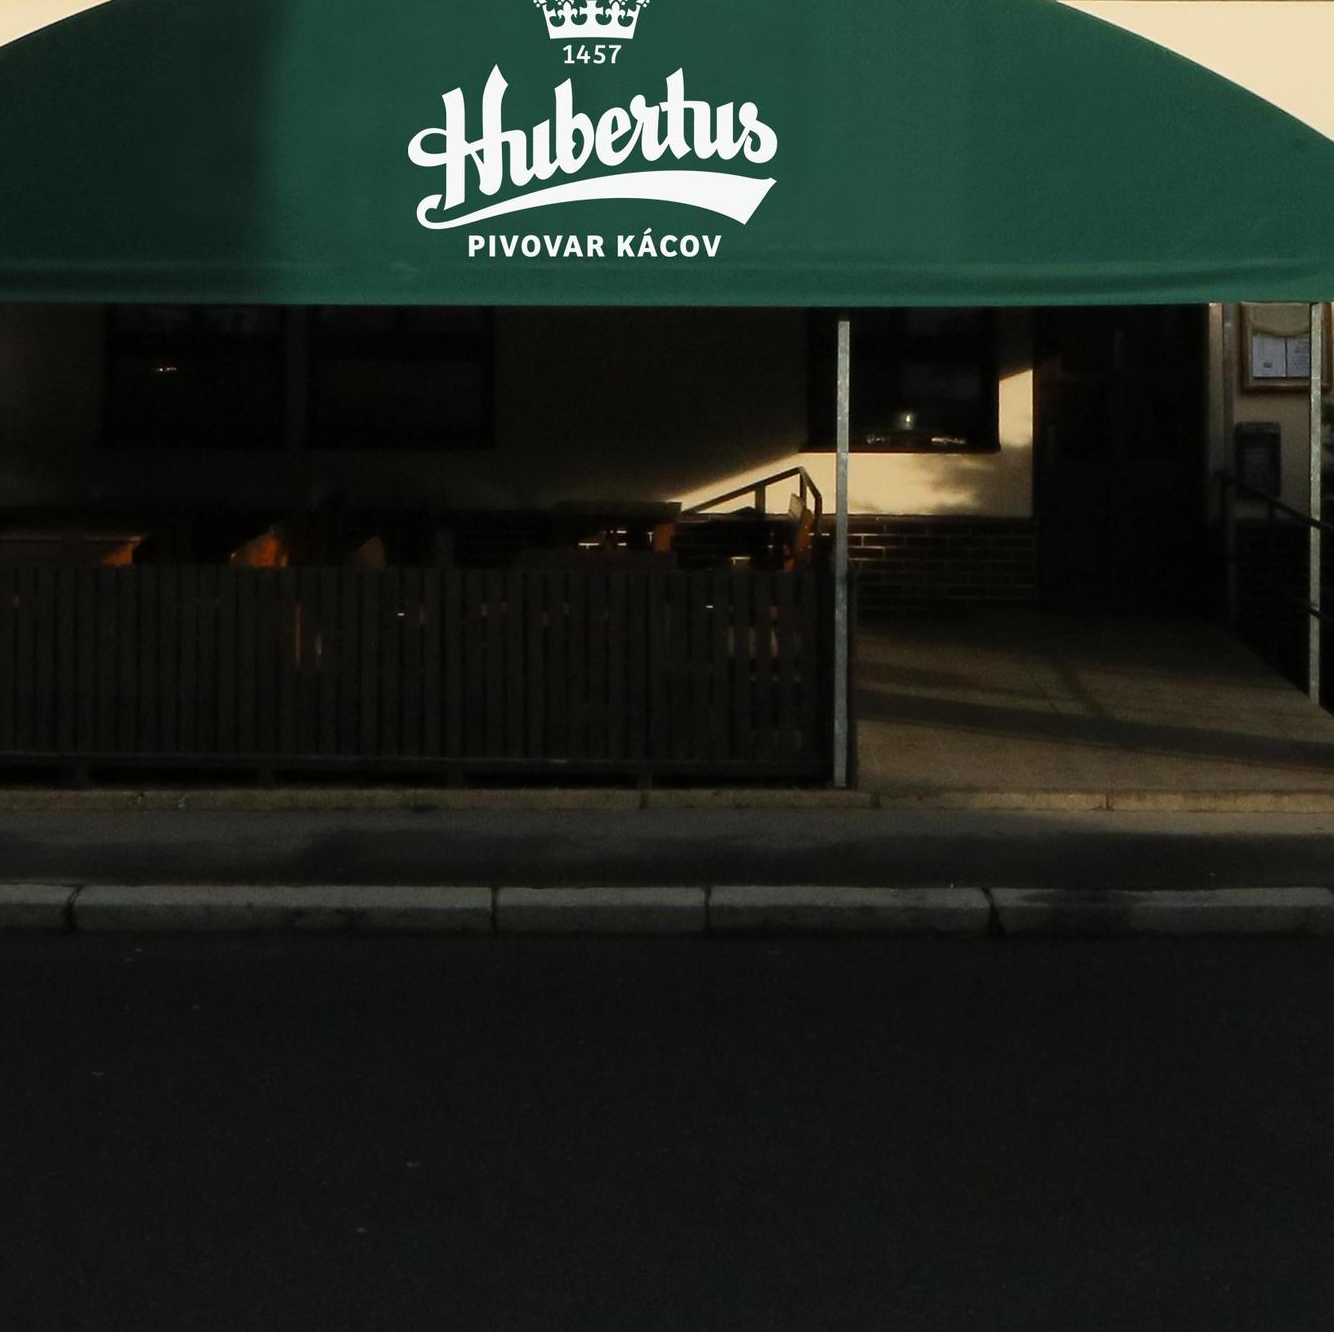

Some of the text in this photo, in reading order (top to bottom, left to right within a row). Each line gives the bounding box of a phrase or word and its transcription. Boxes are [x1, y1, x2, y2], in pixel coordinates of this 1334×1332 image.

[562, 44, 622, 64] 1457
[407, 64, 779, 211] Hubertus
[467, 227, 723, 258] PIVOVAR KÁCOV
